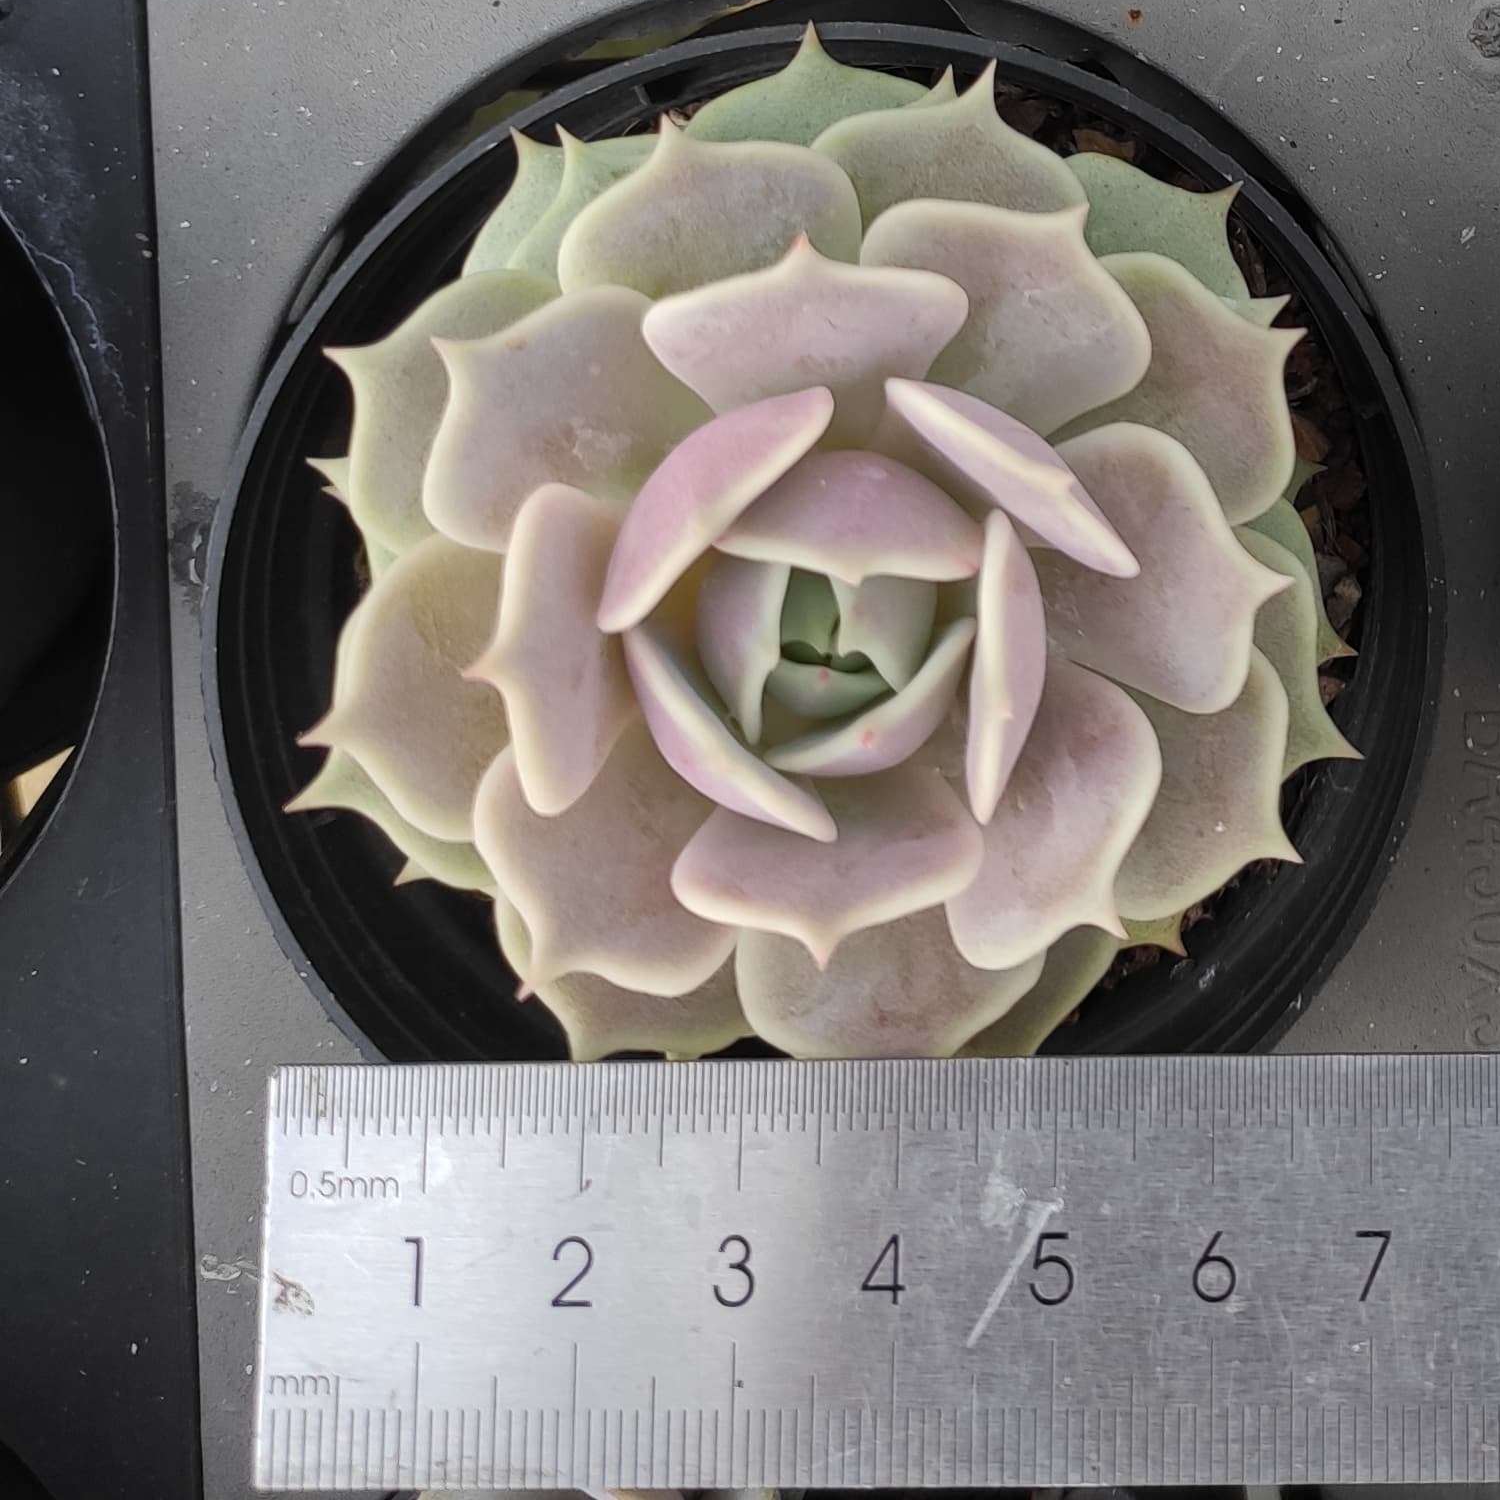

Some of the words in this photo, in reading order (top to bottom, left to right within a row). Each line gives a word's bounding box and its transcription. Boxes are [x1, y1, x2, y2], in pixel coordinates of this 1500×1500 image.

[289, 1169, 400, 1199] 0.5mm
[404, 1236, 423, 1308] 1
[551, 1236, 593, 1307] 2
[713, 1235, 754, 1307] 3
[861, 1234, 905, 1305] 4
[1029, 1232, 1073, 1305] 5
[1193, 1231, 1236, 1303] 6
[1356, 1231, 1391, 1301] 7
[268, 1374, 331, 1396] mm
